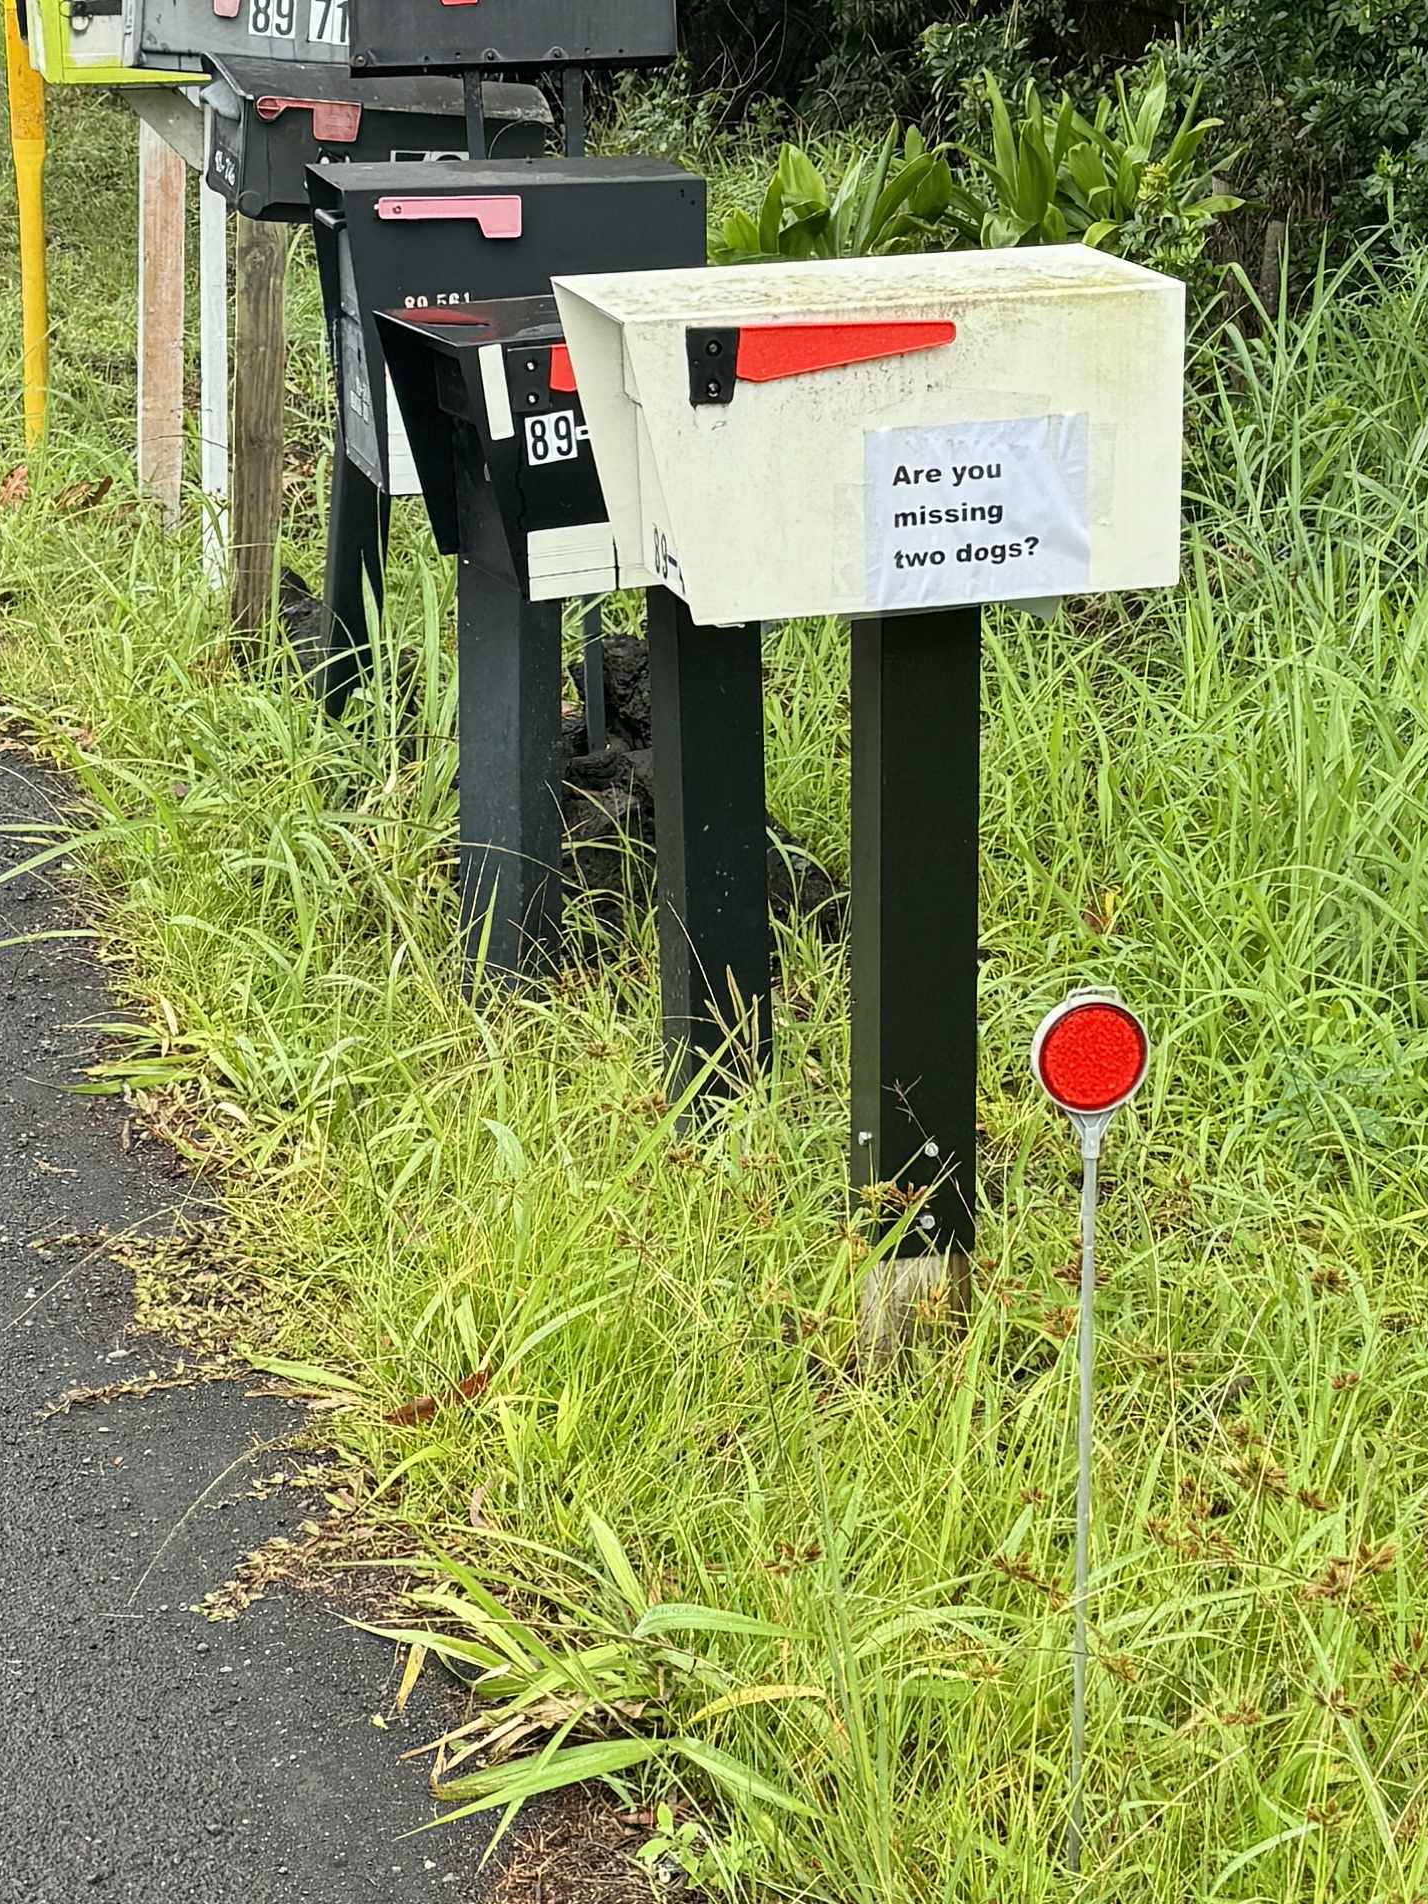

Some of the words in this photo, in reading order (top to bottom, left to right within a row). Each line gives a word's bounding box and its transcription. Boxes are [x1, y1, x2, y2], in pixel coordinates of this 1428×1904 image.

[892, 464, 942, 487] Are
[951, 463, 1002, 487] you
[893, 502, 1004, 528] missing
[893, 549, 946, 569] two
[955, 536, 1040, 565] dogs?
